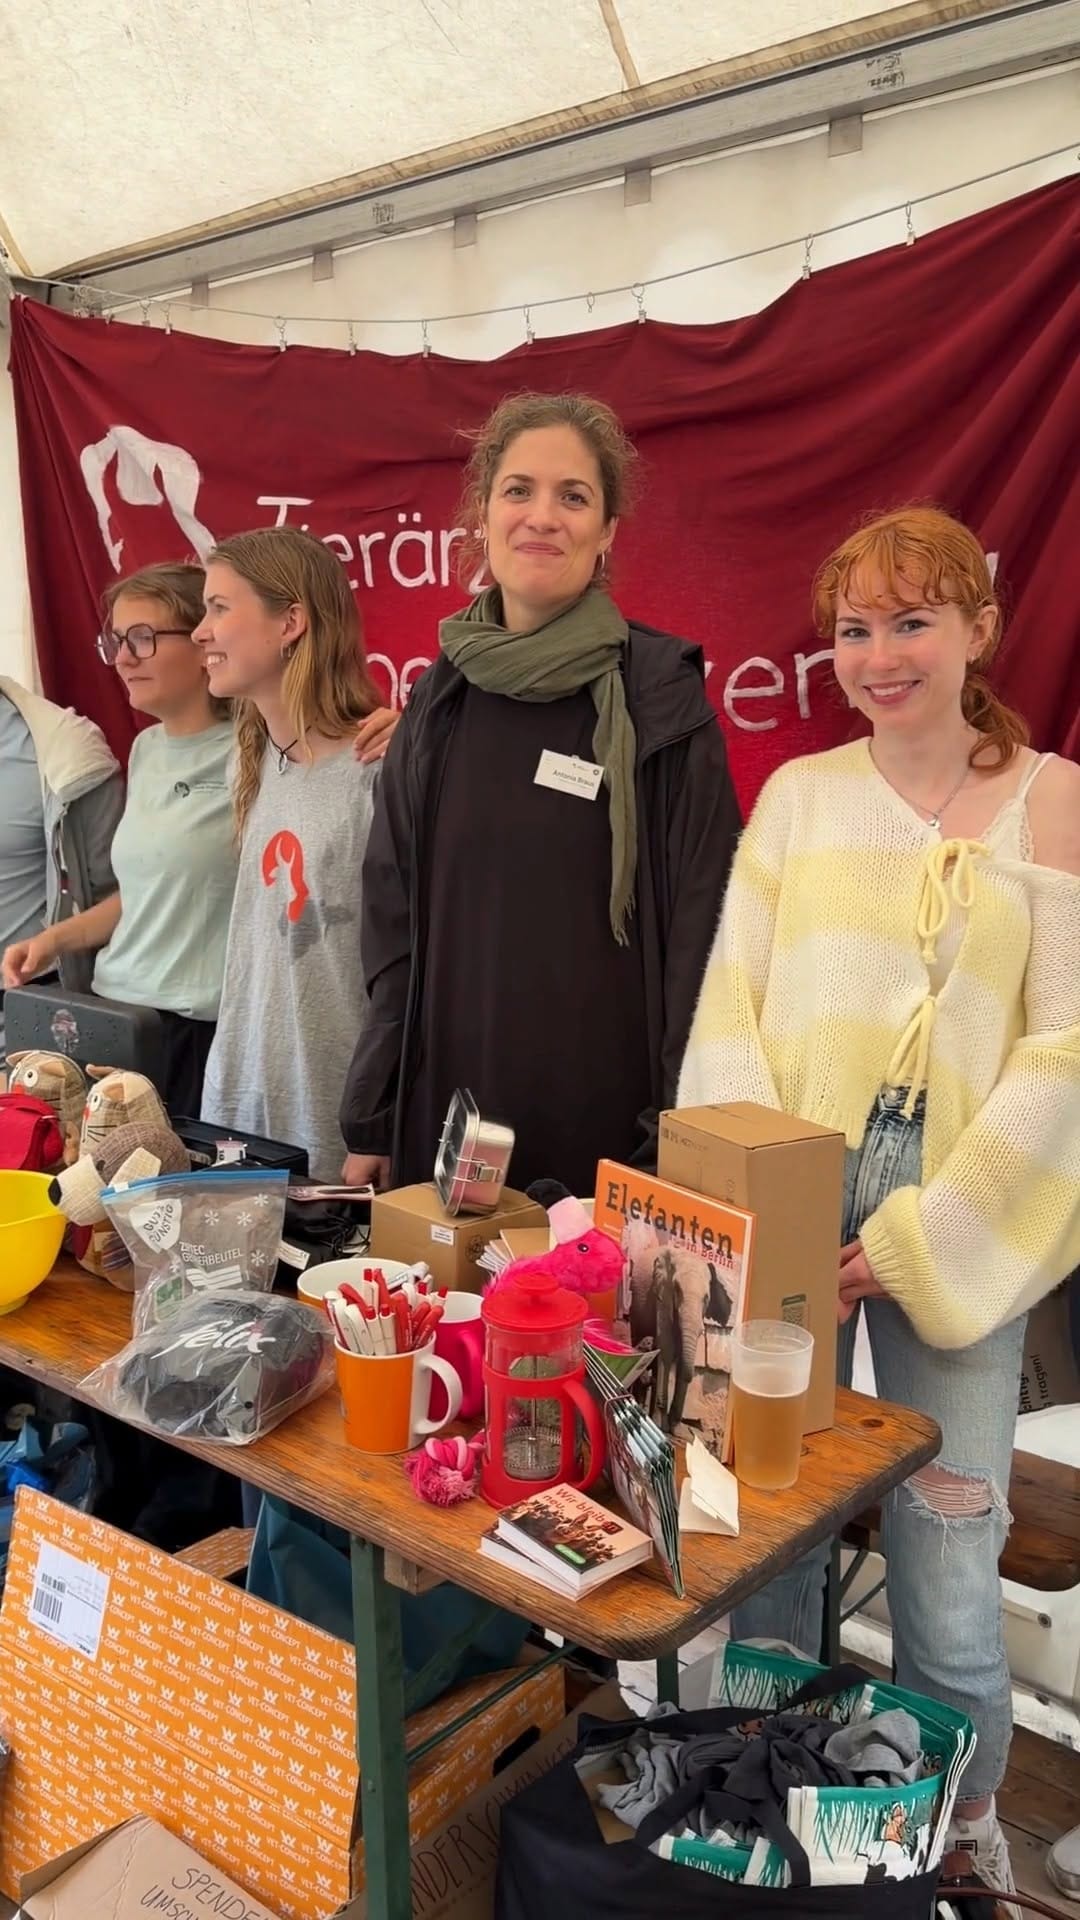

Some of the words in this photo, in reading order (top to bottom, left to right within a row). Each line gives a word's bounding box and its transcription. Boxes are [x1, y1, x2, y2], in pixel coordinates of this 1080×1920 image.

[606, 1181, 733, 1260] Elefanten
[701, 1248, 735, 1270] Berlin
[326, 1657, 357, 1681] VET-CON
